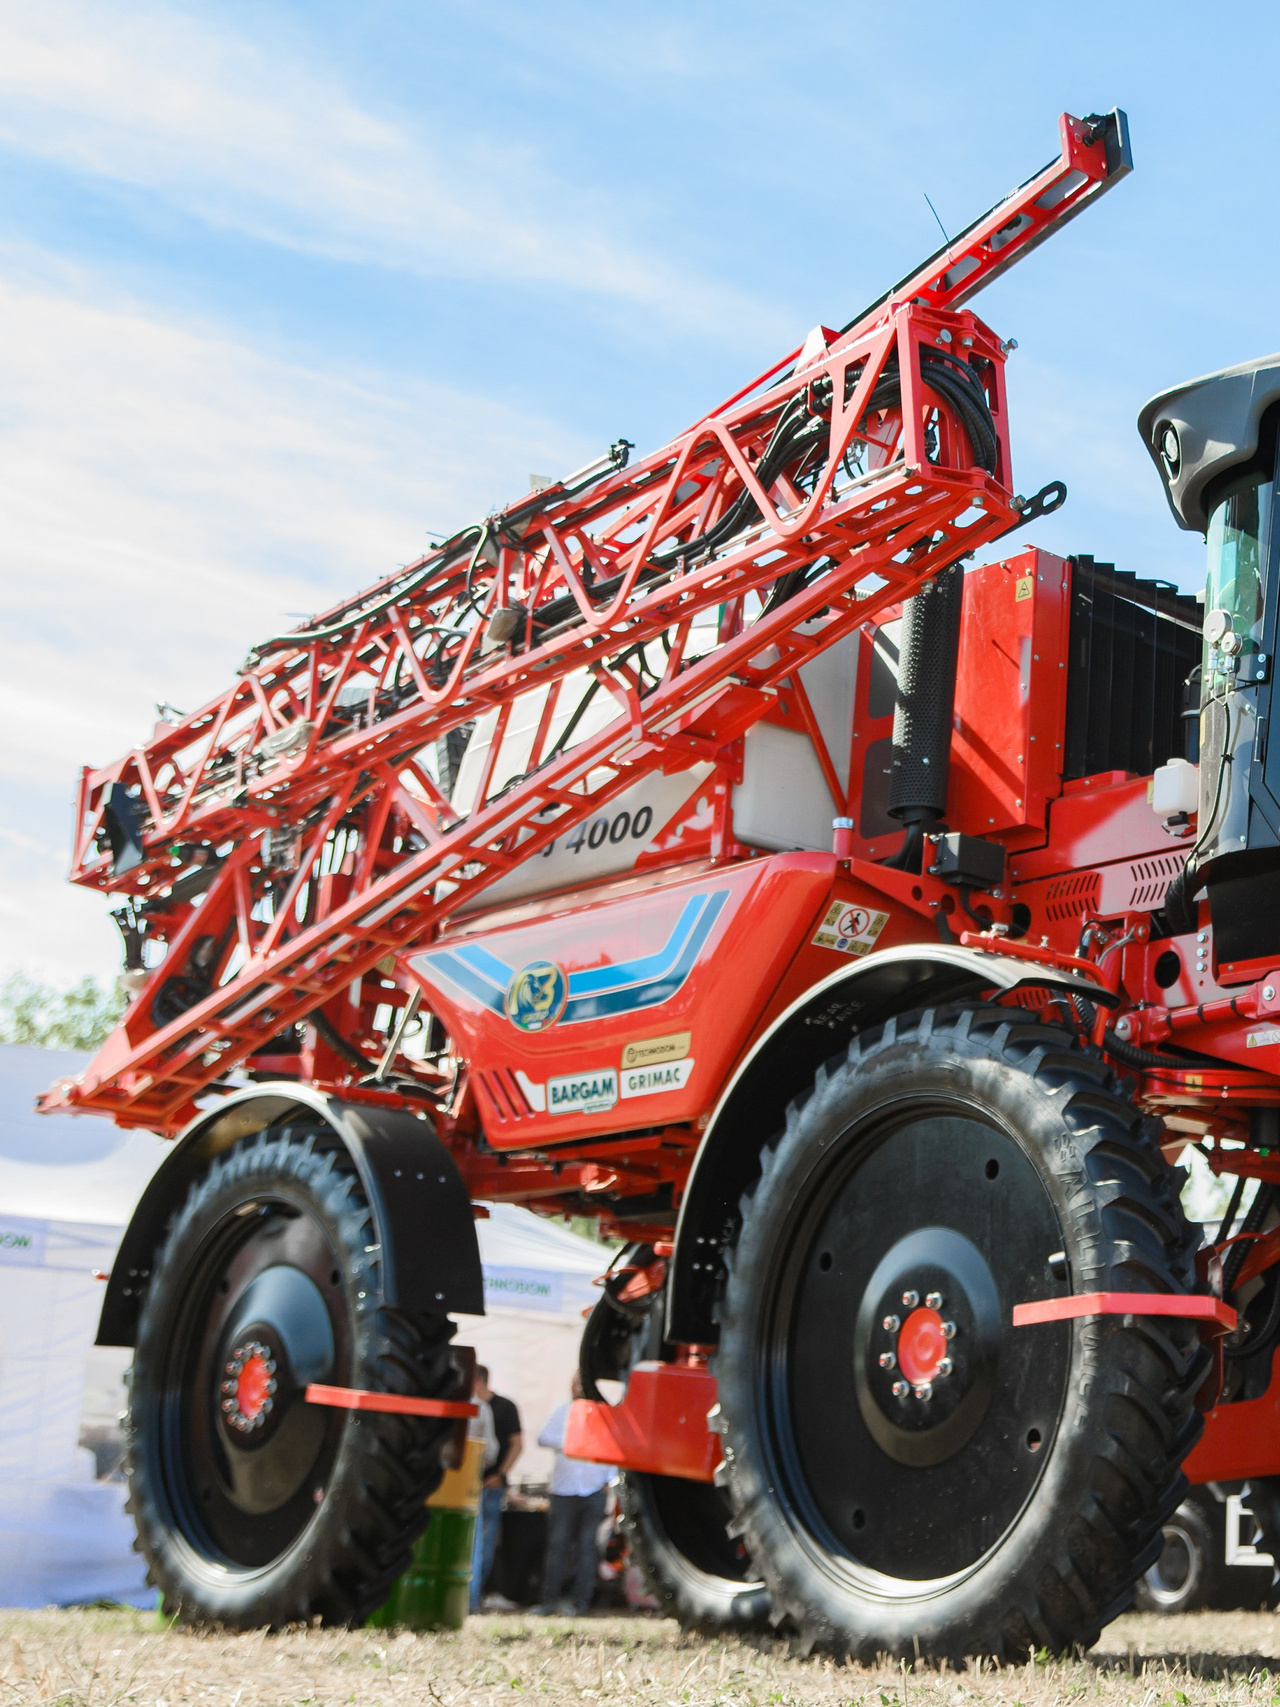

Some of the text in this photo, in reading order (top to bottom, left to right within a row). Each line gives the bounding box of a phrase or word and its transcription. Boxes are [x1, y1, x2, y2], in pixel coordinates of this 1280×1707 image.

[565, 806, 653, 854] 4000
[551, 1077, 614, 1105] BARGAM
[628, 1067, 680, 1090] GRIMAC
[1056, 1169, 1106, 1427] ALLINCE
